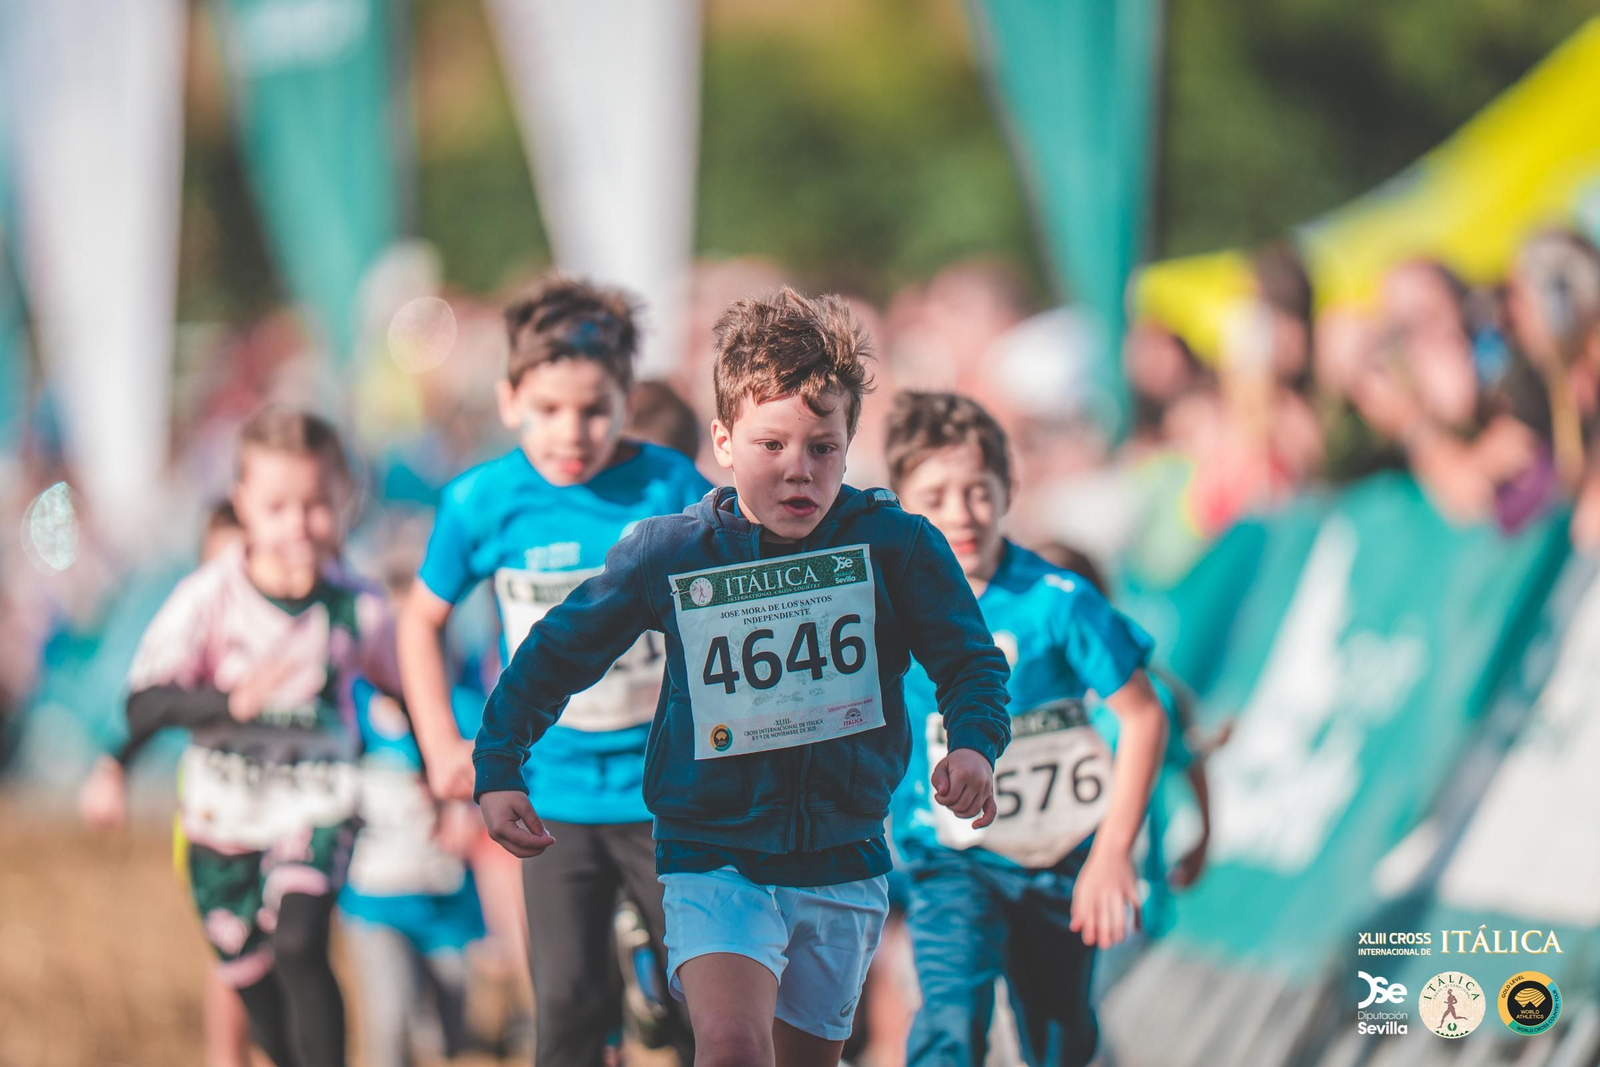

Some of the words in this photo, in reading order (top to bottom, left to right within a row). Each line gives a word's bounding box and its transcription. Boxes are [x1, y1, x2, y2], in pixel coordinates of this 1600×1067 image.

[724, 565, 819, 597] ITÁLICA
[720, 609, 740, 619] JOSE
[741, 606, 766, 616] MORA
[768, 603, 780, 611] DE
[781, 600, 799, 610] LOS
[799, 594, 833, 606] SANTOS
[743, 608, 811, 625] INDEPENDIENTE
[702, 614, 867, 694] 4646
[743, 729, 758, 737] CROSS
[759, 723, 798, 735] INTERNACIONAL
[770, 727, 799, 738] NOVIEMBRE
[800, 725, 807, 733] DE
